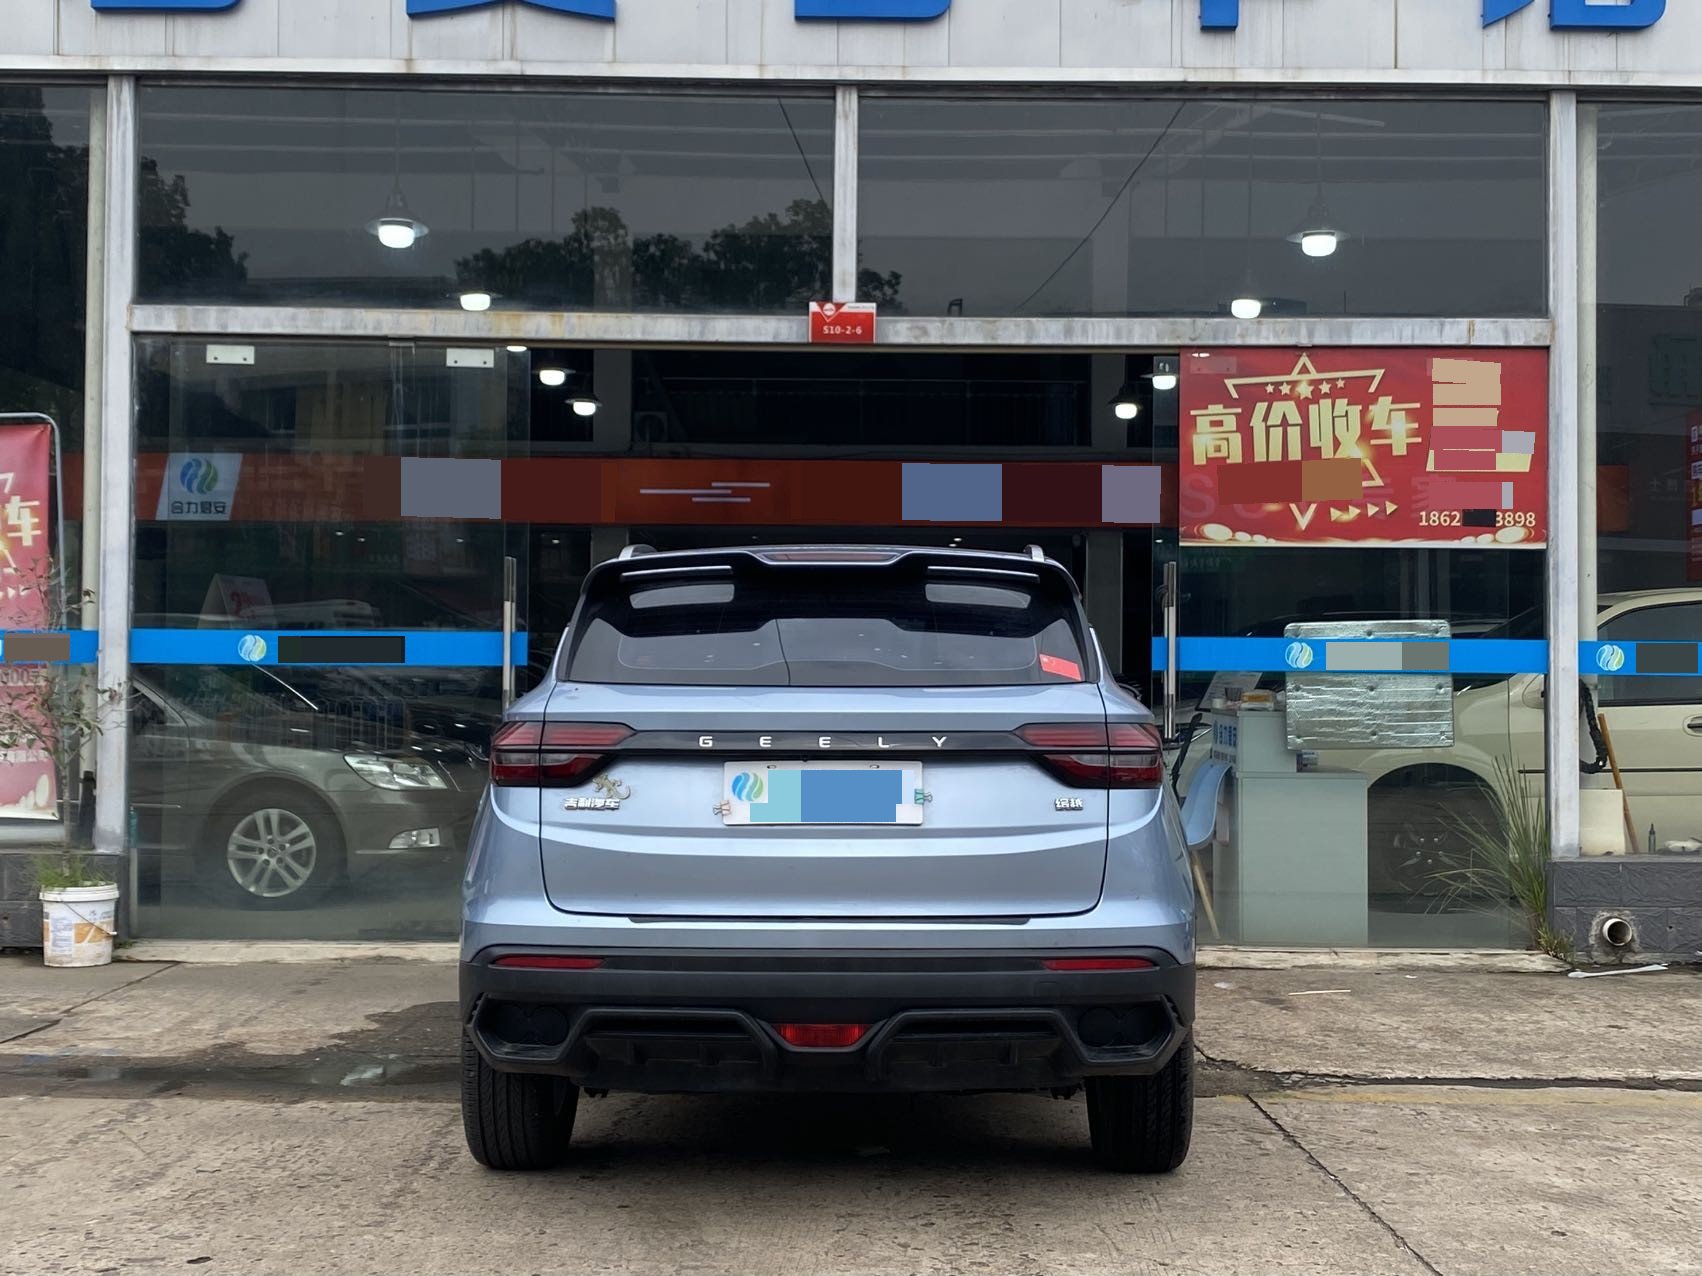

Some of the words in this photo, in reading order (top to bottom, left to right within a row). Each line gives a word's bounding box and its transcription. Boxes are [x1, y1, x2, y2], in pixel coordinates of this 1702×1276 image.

[823, 325, 862, 335] S10-2-6
[1190, 396, 1422, 466] 高价收车
[1419, 511, 1536, 527] 18623898
[699, 736, 947, 748] GEELY
[564, 798, 619, 810] 吉利汽车
